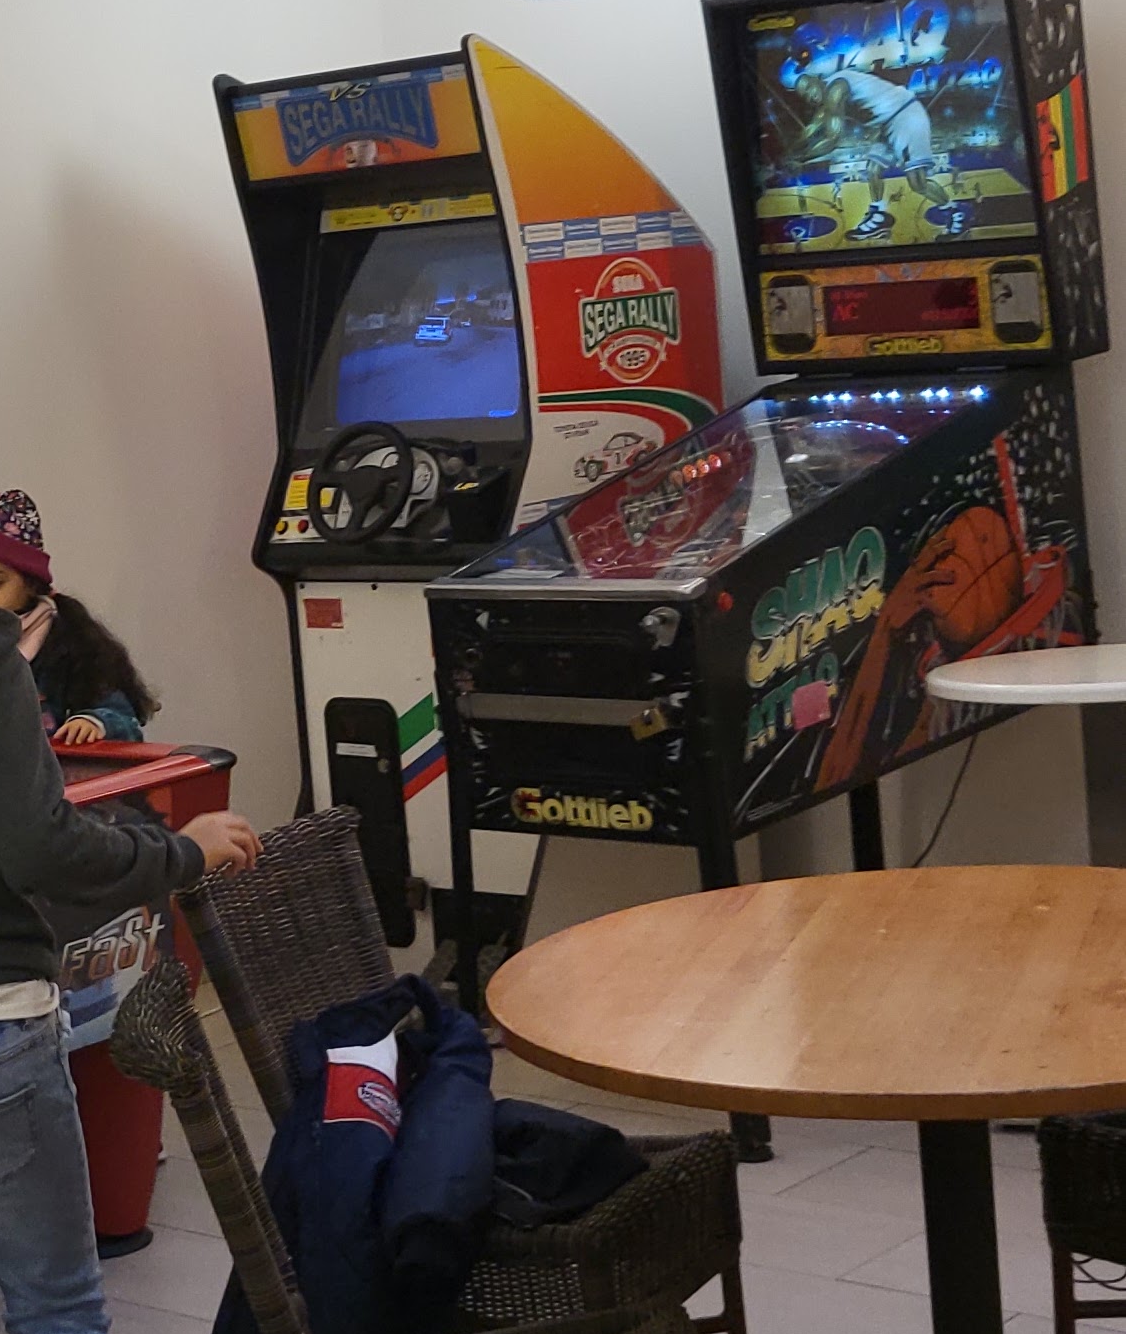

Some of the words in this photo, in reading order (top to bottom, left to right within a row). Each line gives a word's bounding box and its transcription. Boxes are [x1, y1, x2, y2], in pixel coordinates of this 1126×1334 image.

[283, 99, 347, 157] SEGA
[348, 85, 425, 144] RALLY
[584, 300, 625, 347] SEGA
[627, 295, 675, 335] RALLY
[511, 787, 653, 832] Gottlieb
